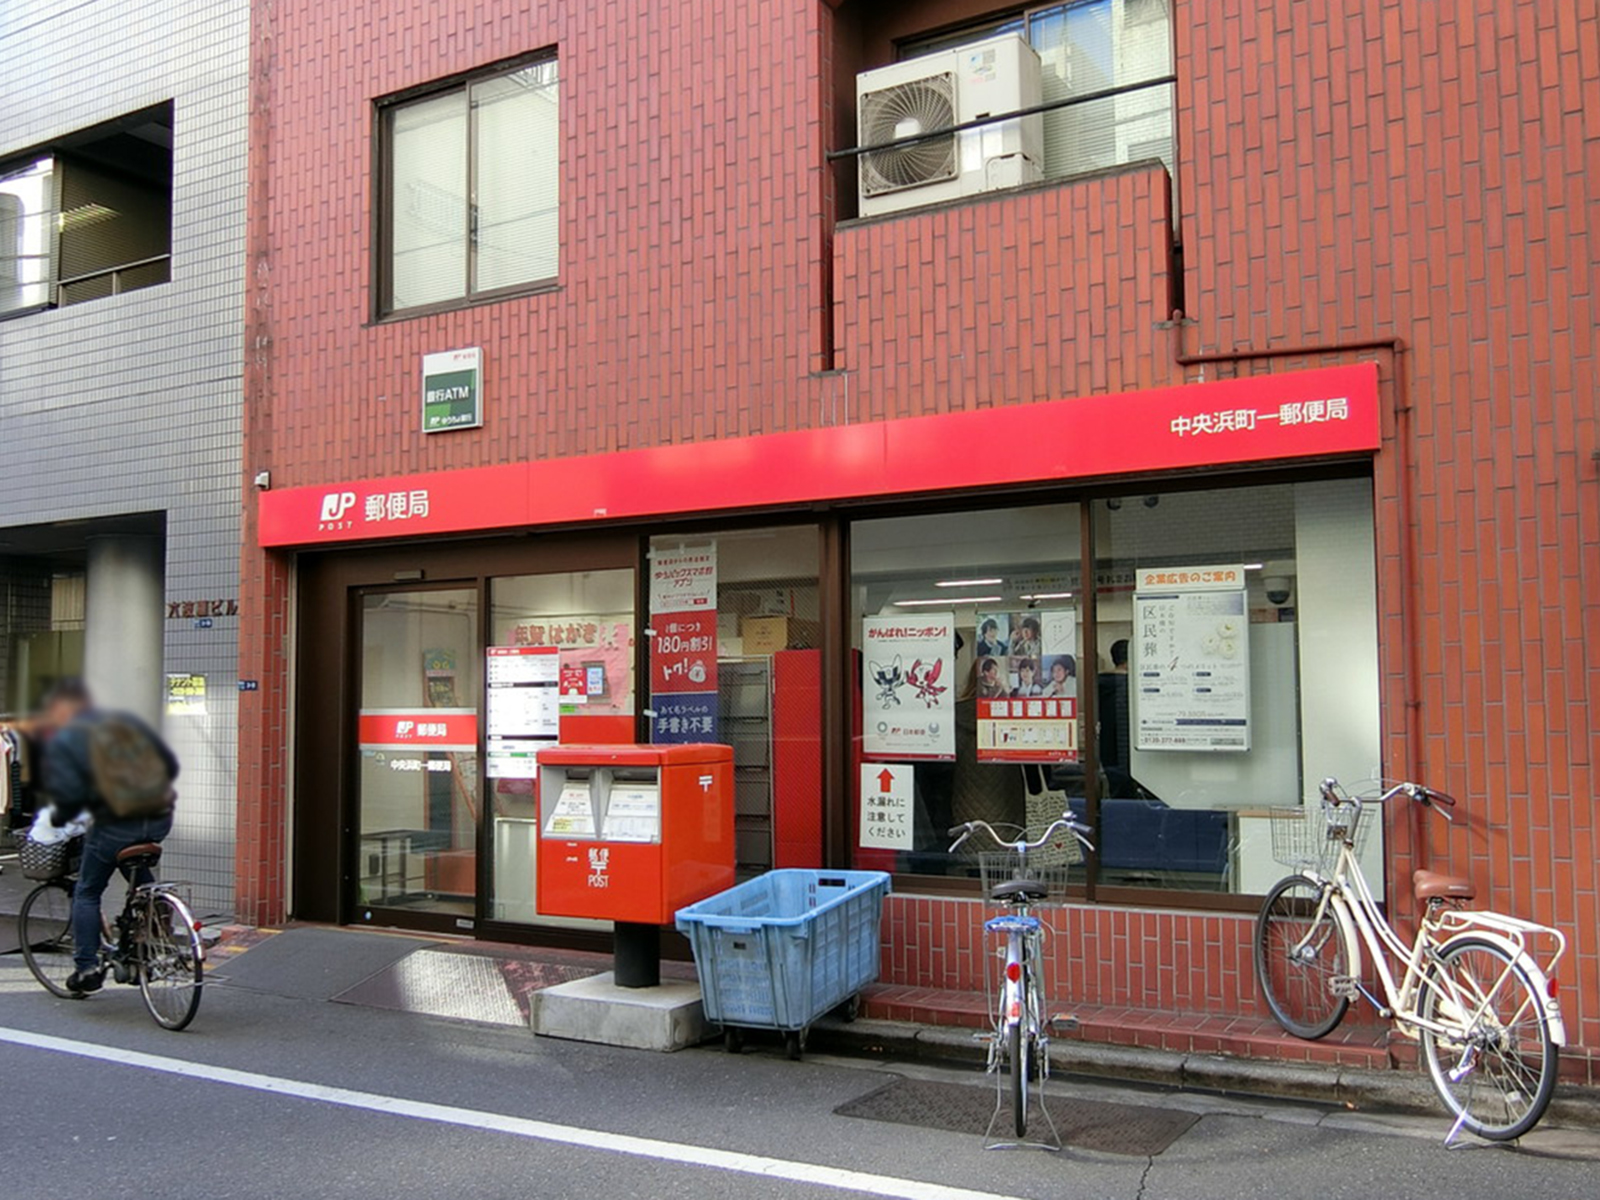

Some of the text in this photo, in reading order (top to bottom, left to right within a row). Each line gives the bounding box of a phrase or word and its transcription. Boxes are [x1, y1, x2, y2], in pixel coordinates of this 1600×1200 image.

[427, 385, 469, 403] 銀行ATM
[1170, 397, 1348, 437] 中央浜町一郵便局
[364, 490, 429, 521] 郵便局
[318, 520, 352, 531] POST
[1145, 571, 1236, 585] 企業広告のご案内
[665, 622, 701, 633] 1個につき
[1143, 605, 1158, 657] 区民葬
[657, 635, 713, 653] 180円割引
[663, 658, 688, 681] トク!
[417, 723, 447, 737] 郵便局
[657, 716, 713, 733] 手書き不要
[390, 759, 452, 772] 中央浜町一郵便局
[867, 796, 906, 807] 水漏れに
[867, 811, 905, 823] 注意して
[868, 826, 906, 838] ください
[588, 847, 609, 862] 郵便
[588, 875, 609, 887] POST
